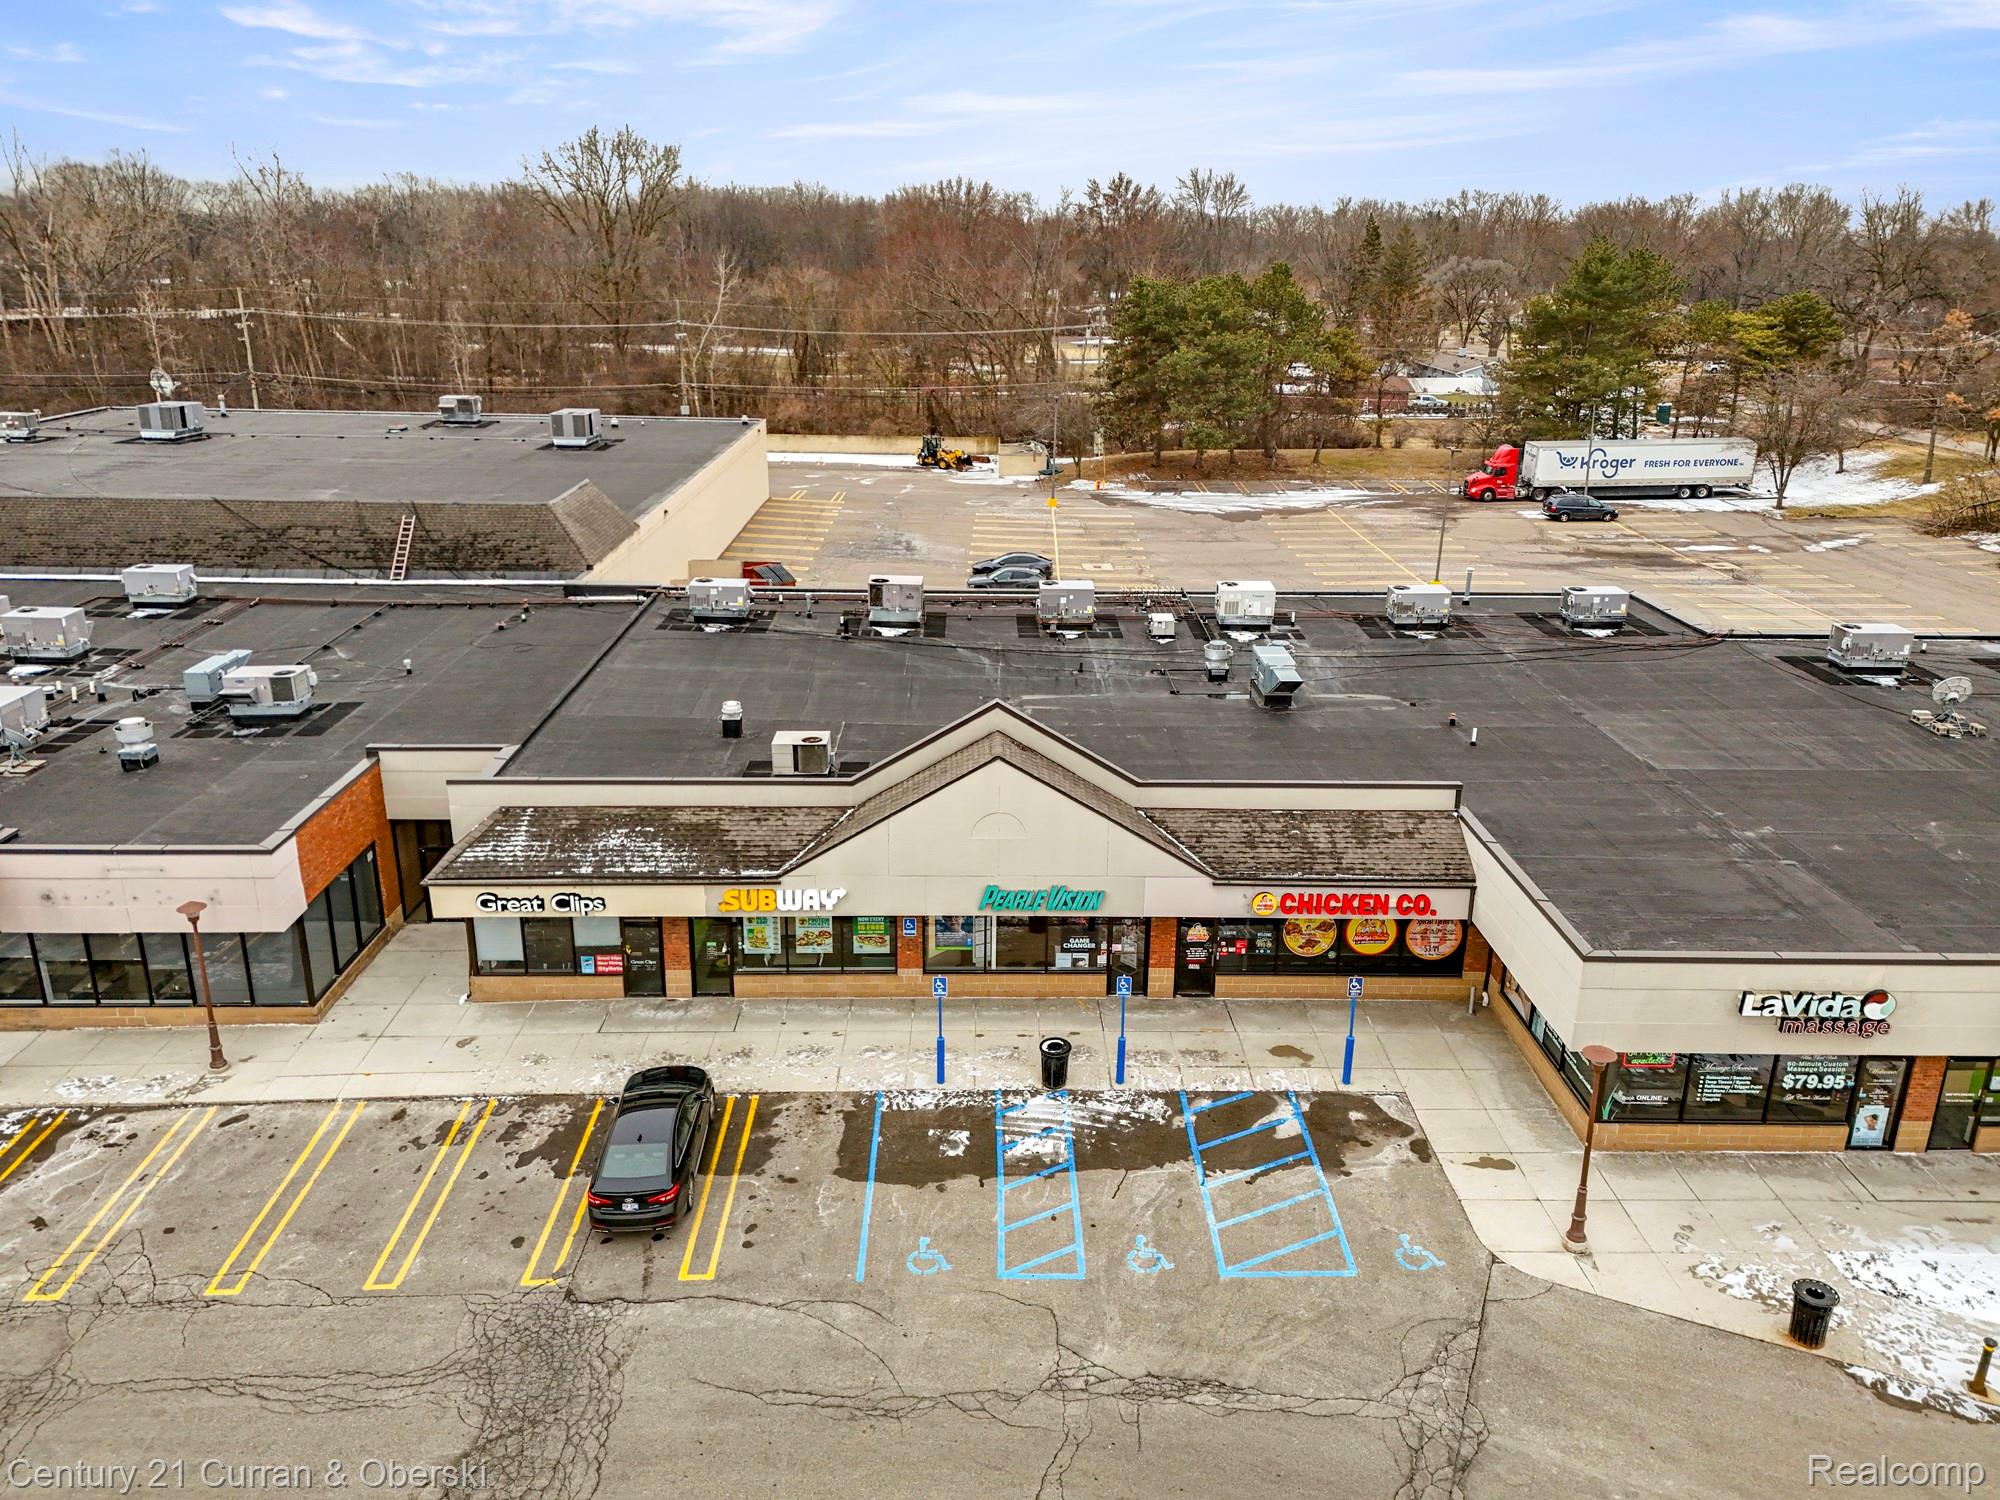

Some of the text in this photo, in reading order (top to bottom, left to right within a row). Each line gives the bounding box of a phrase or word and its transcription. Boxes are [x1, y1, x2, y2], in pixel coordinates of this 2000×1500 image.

[1644, 460, 1671, 468] FRESH
[1672, 459, 1691, 467] FOR
[1693, 458, 1739, 467] EVERYONE
[476, 893, 606, 916] Great Clips
[718, 888, 848, 912] SUBWAY
[978, 885, 1105, 912] PEARLE VISION
[1279, 893, 1437, 916] CHICKEN CO.
[1739, 991, 1861, 1018] LaVida
[1780, 1019, 1891, 1039] massage
[1781, 1073, 1846, 1090] $79.95
